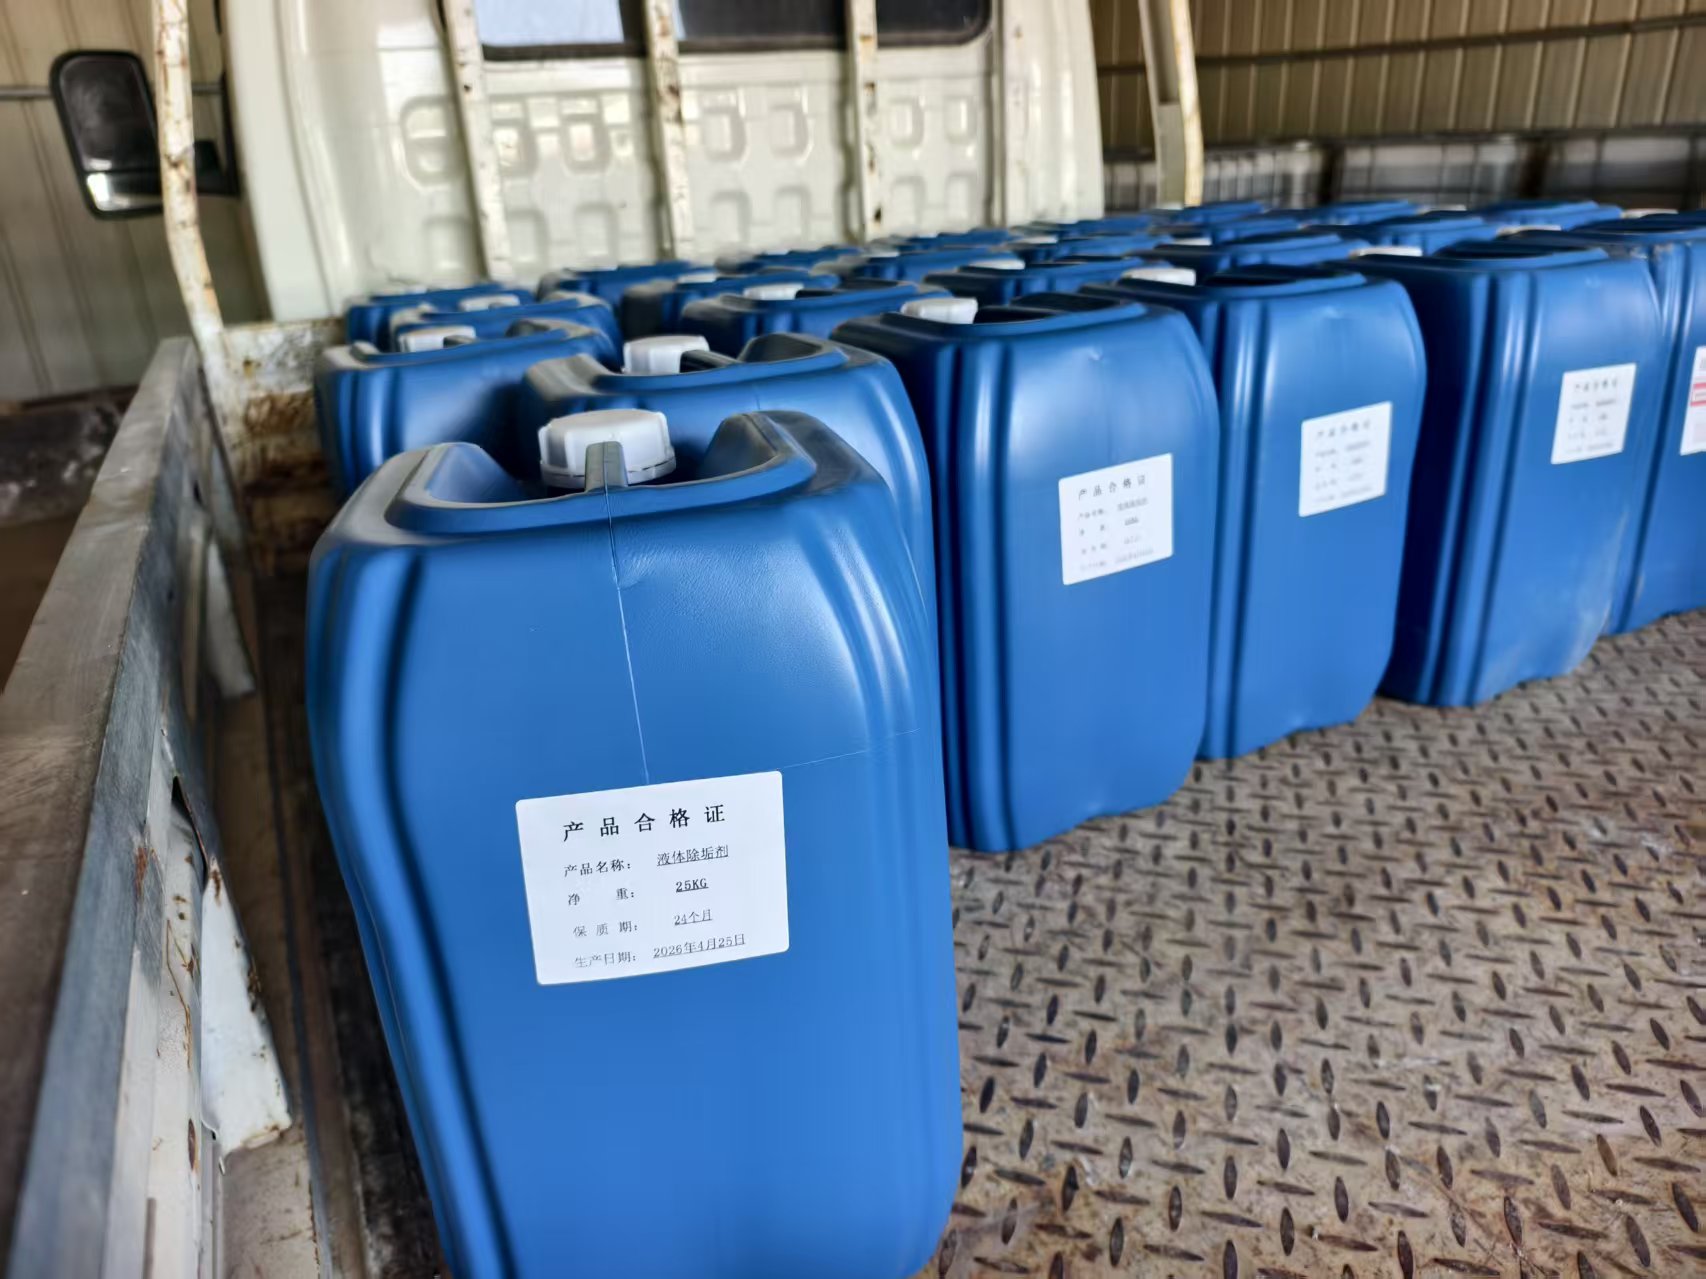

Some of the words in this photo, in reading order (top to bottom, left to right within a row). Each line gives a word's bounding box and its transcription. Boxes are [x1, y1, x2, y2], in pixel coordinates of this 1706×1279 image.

[562, 804, 726, 842] 产品合格证
[657, 844, 729, 866] 液体除垢剂
[675, 878, 709, 893] 25KG
[674, 908, 713, 926] 24个月
